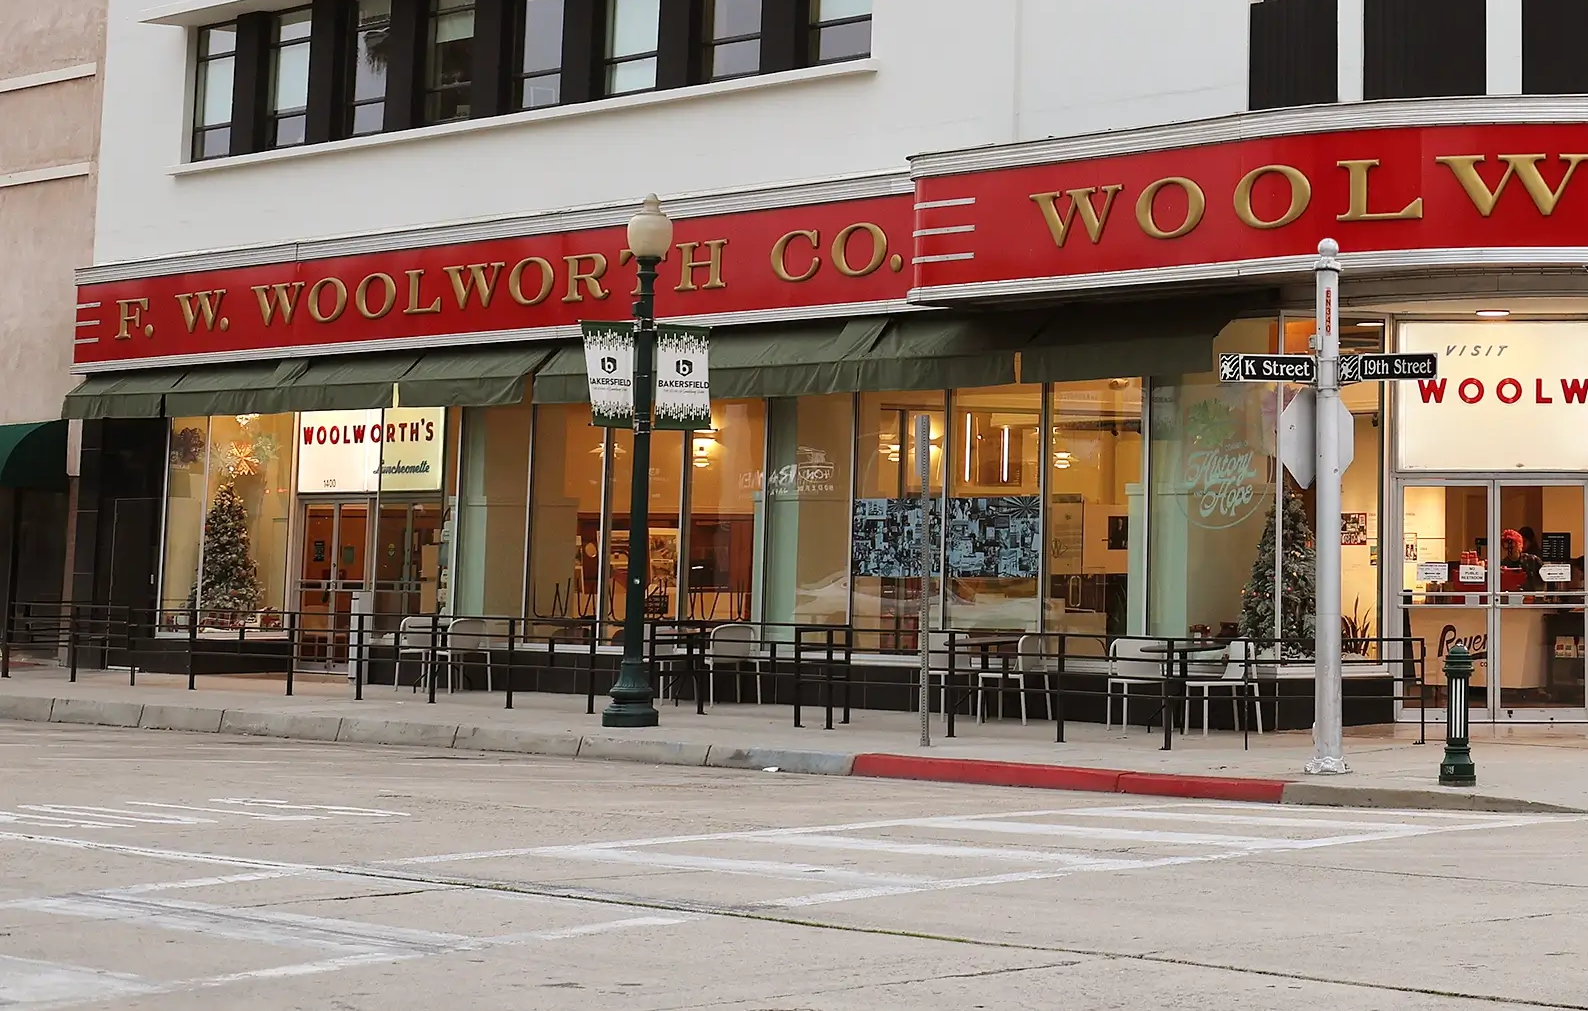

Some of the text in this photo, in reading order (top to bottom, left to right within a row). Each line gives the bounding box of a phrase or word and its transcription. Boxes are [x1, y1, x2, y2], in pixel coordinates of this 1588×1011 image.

[114, 297, 154, 340] F.
[175, 288, 229, 334] W.
[770, 222, 904, 284] CO.
[1446, 344, 1509, 357] VISIT
[1244, 360, 1311, 377] K Street
[1363, 358, 1433, 375] 19th Street
[658, 379, 709, 389] BAKERSFIELD
[303, 418, 434, 445] WOOLWORTH'S
